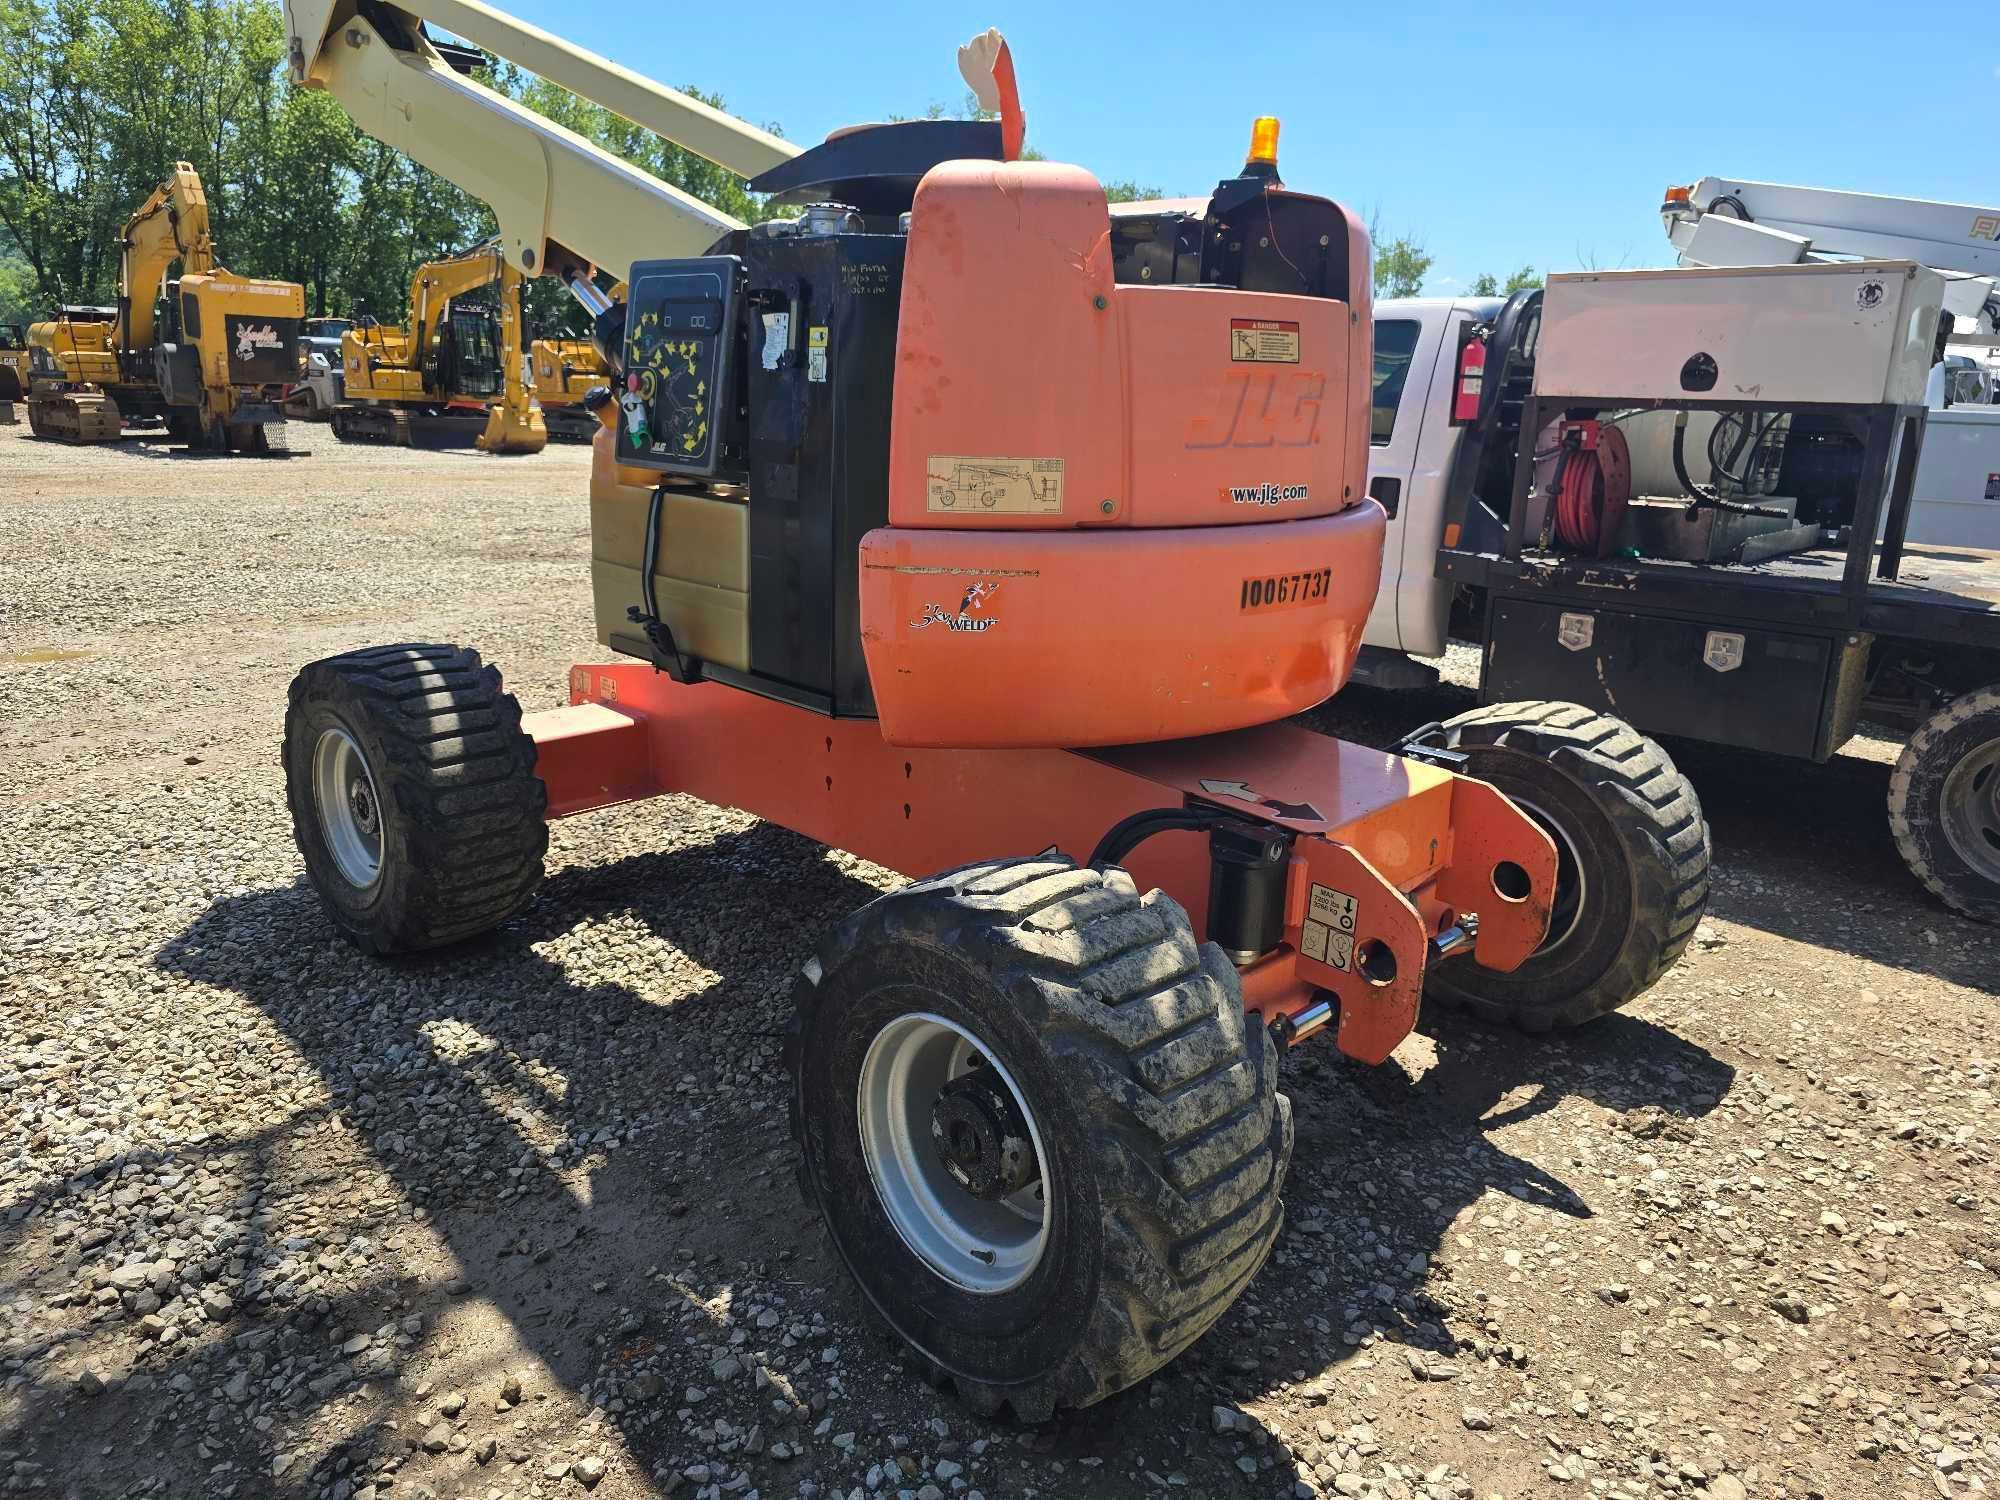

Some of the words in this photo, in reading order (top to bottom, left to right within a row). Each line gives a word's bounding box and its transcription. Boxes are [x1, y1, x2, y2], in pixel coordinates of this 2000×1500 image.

[3, 357, 18, 366] CAT
[1185, 367, 1326, 449] JLG
[1229, 484, 1308, 504] ww.jlg.com
[1240, 567, 1332, 609] 10067737
